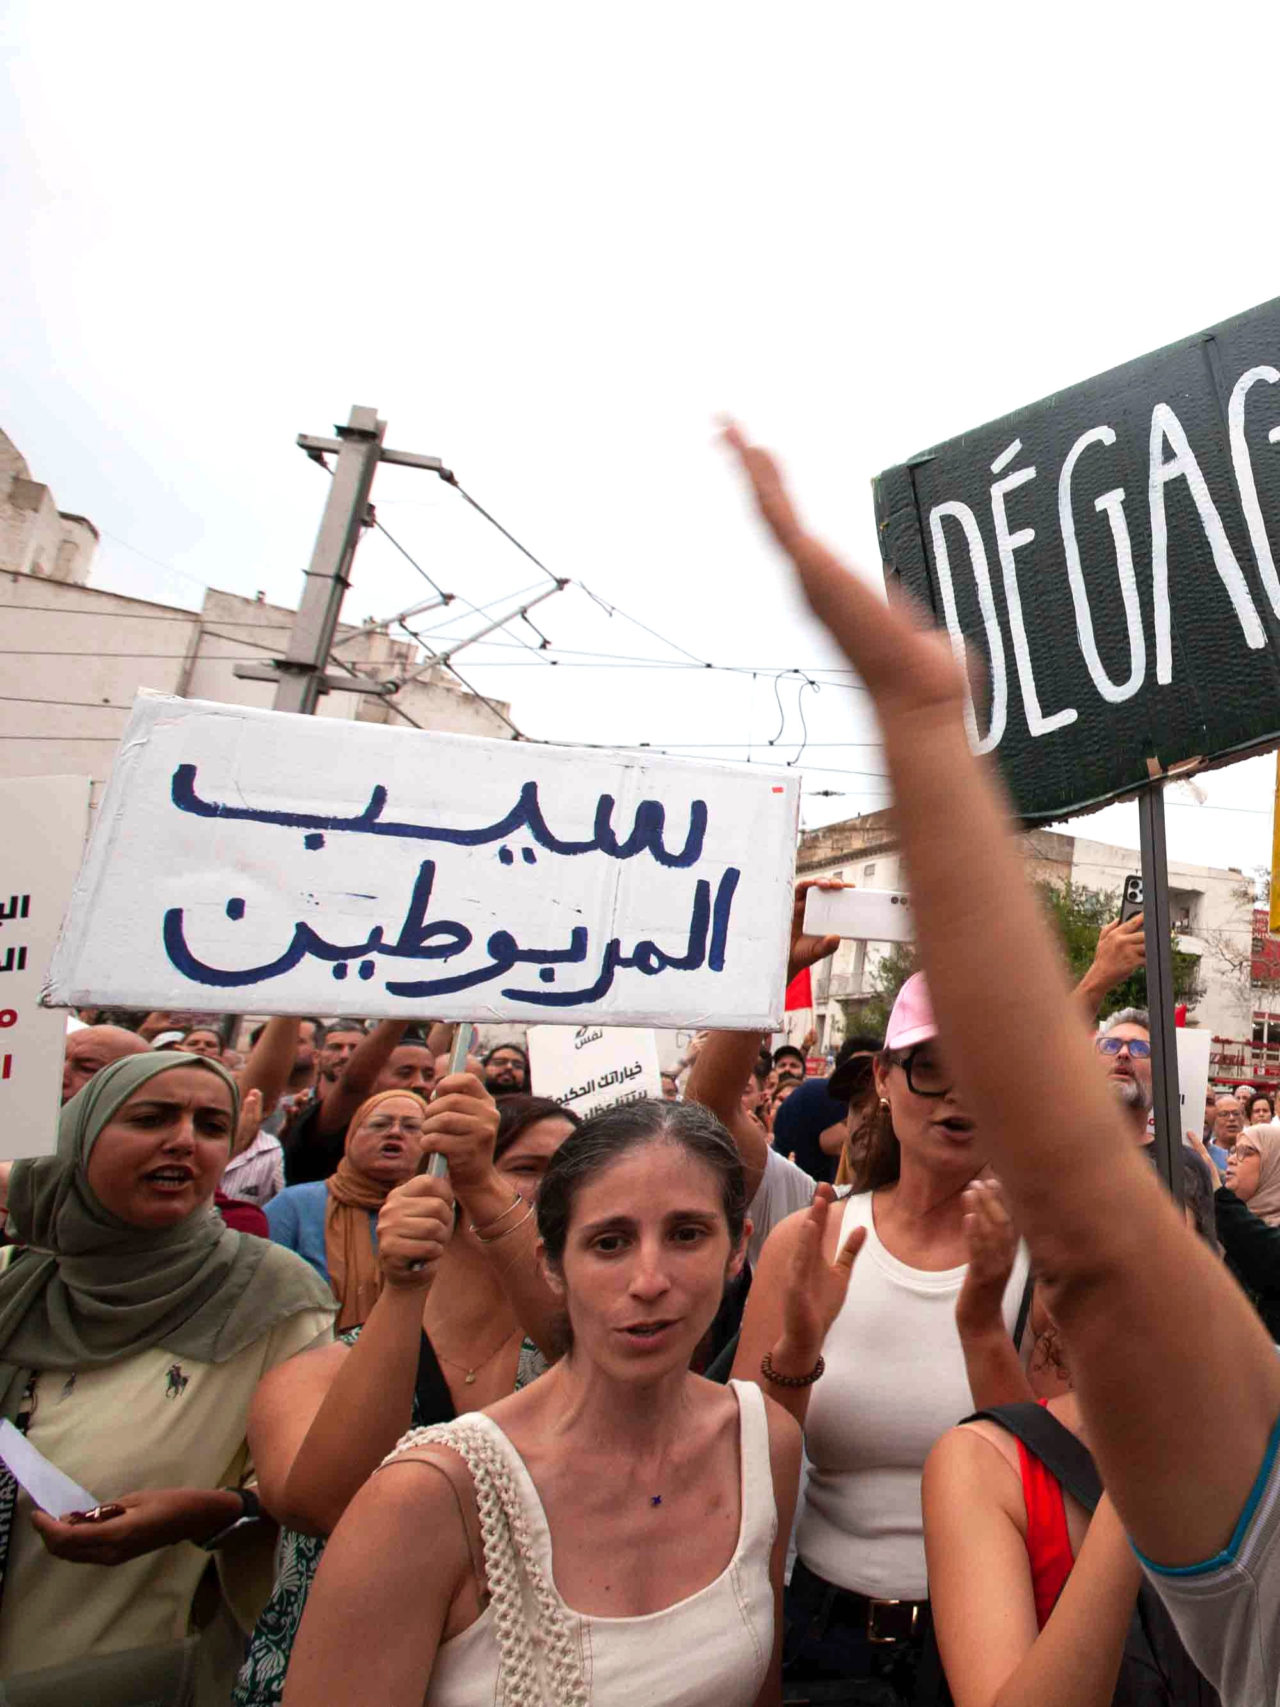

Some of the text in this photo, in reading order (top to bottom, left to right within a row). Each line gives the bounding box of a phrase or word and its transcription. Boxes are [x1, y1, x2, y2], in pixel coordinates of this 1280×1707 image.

[171, 763, 708, 868] سيب
[163, 859, 741, 1007] المربوطين
[598, 1061, 643, 1089] خياراتك
